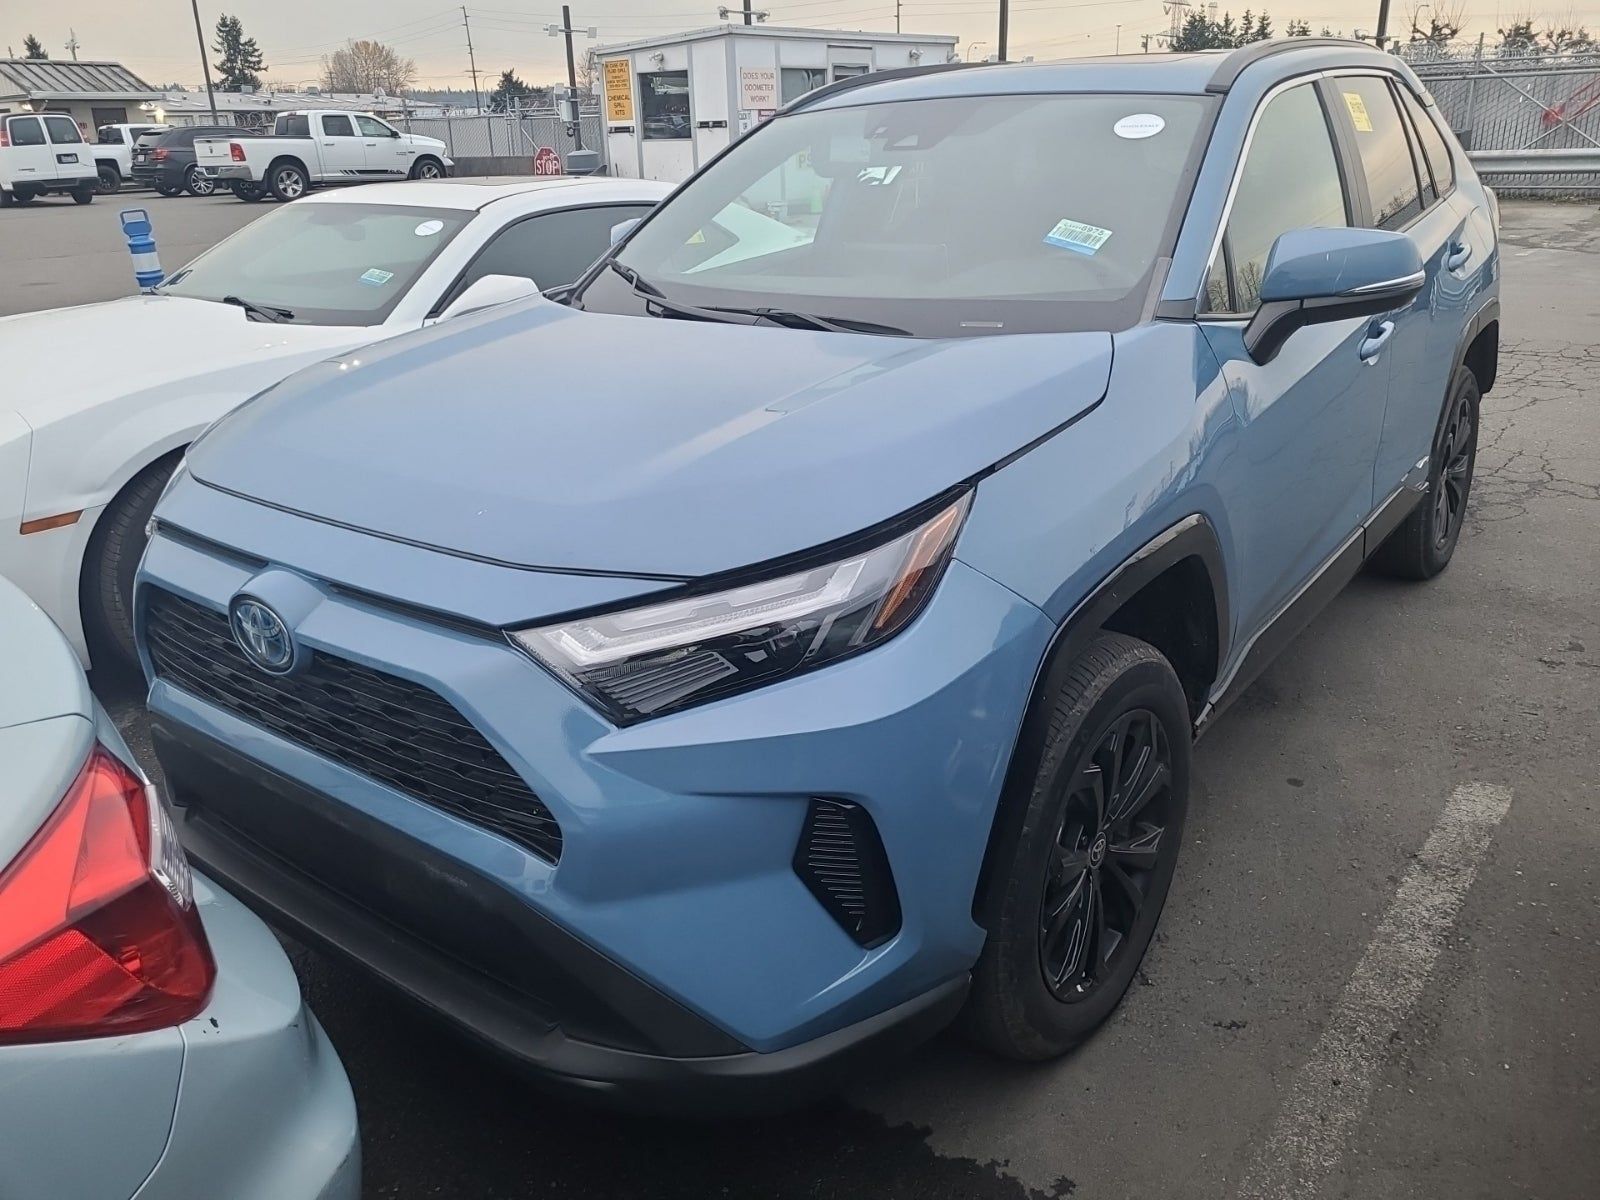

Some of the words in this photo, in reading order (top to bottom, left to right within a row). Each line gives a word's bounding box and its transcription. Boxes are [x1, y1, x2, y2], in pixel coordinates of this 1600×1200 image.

[760, 72, 774, 80] YOUR
[744, 83, 774, 91] ODOMETER
[536, 159, 559, 175] STOP
